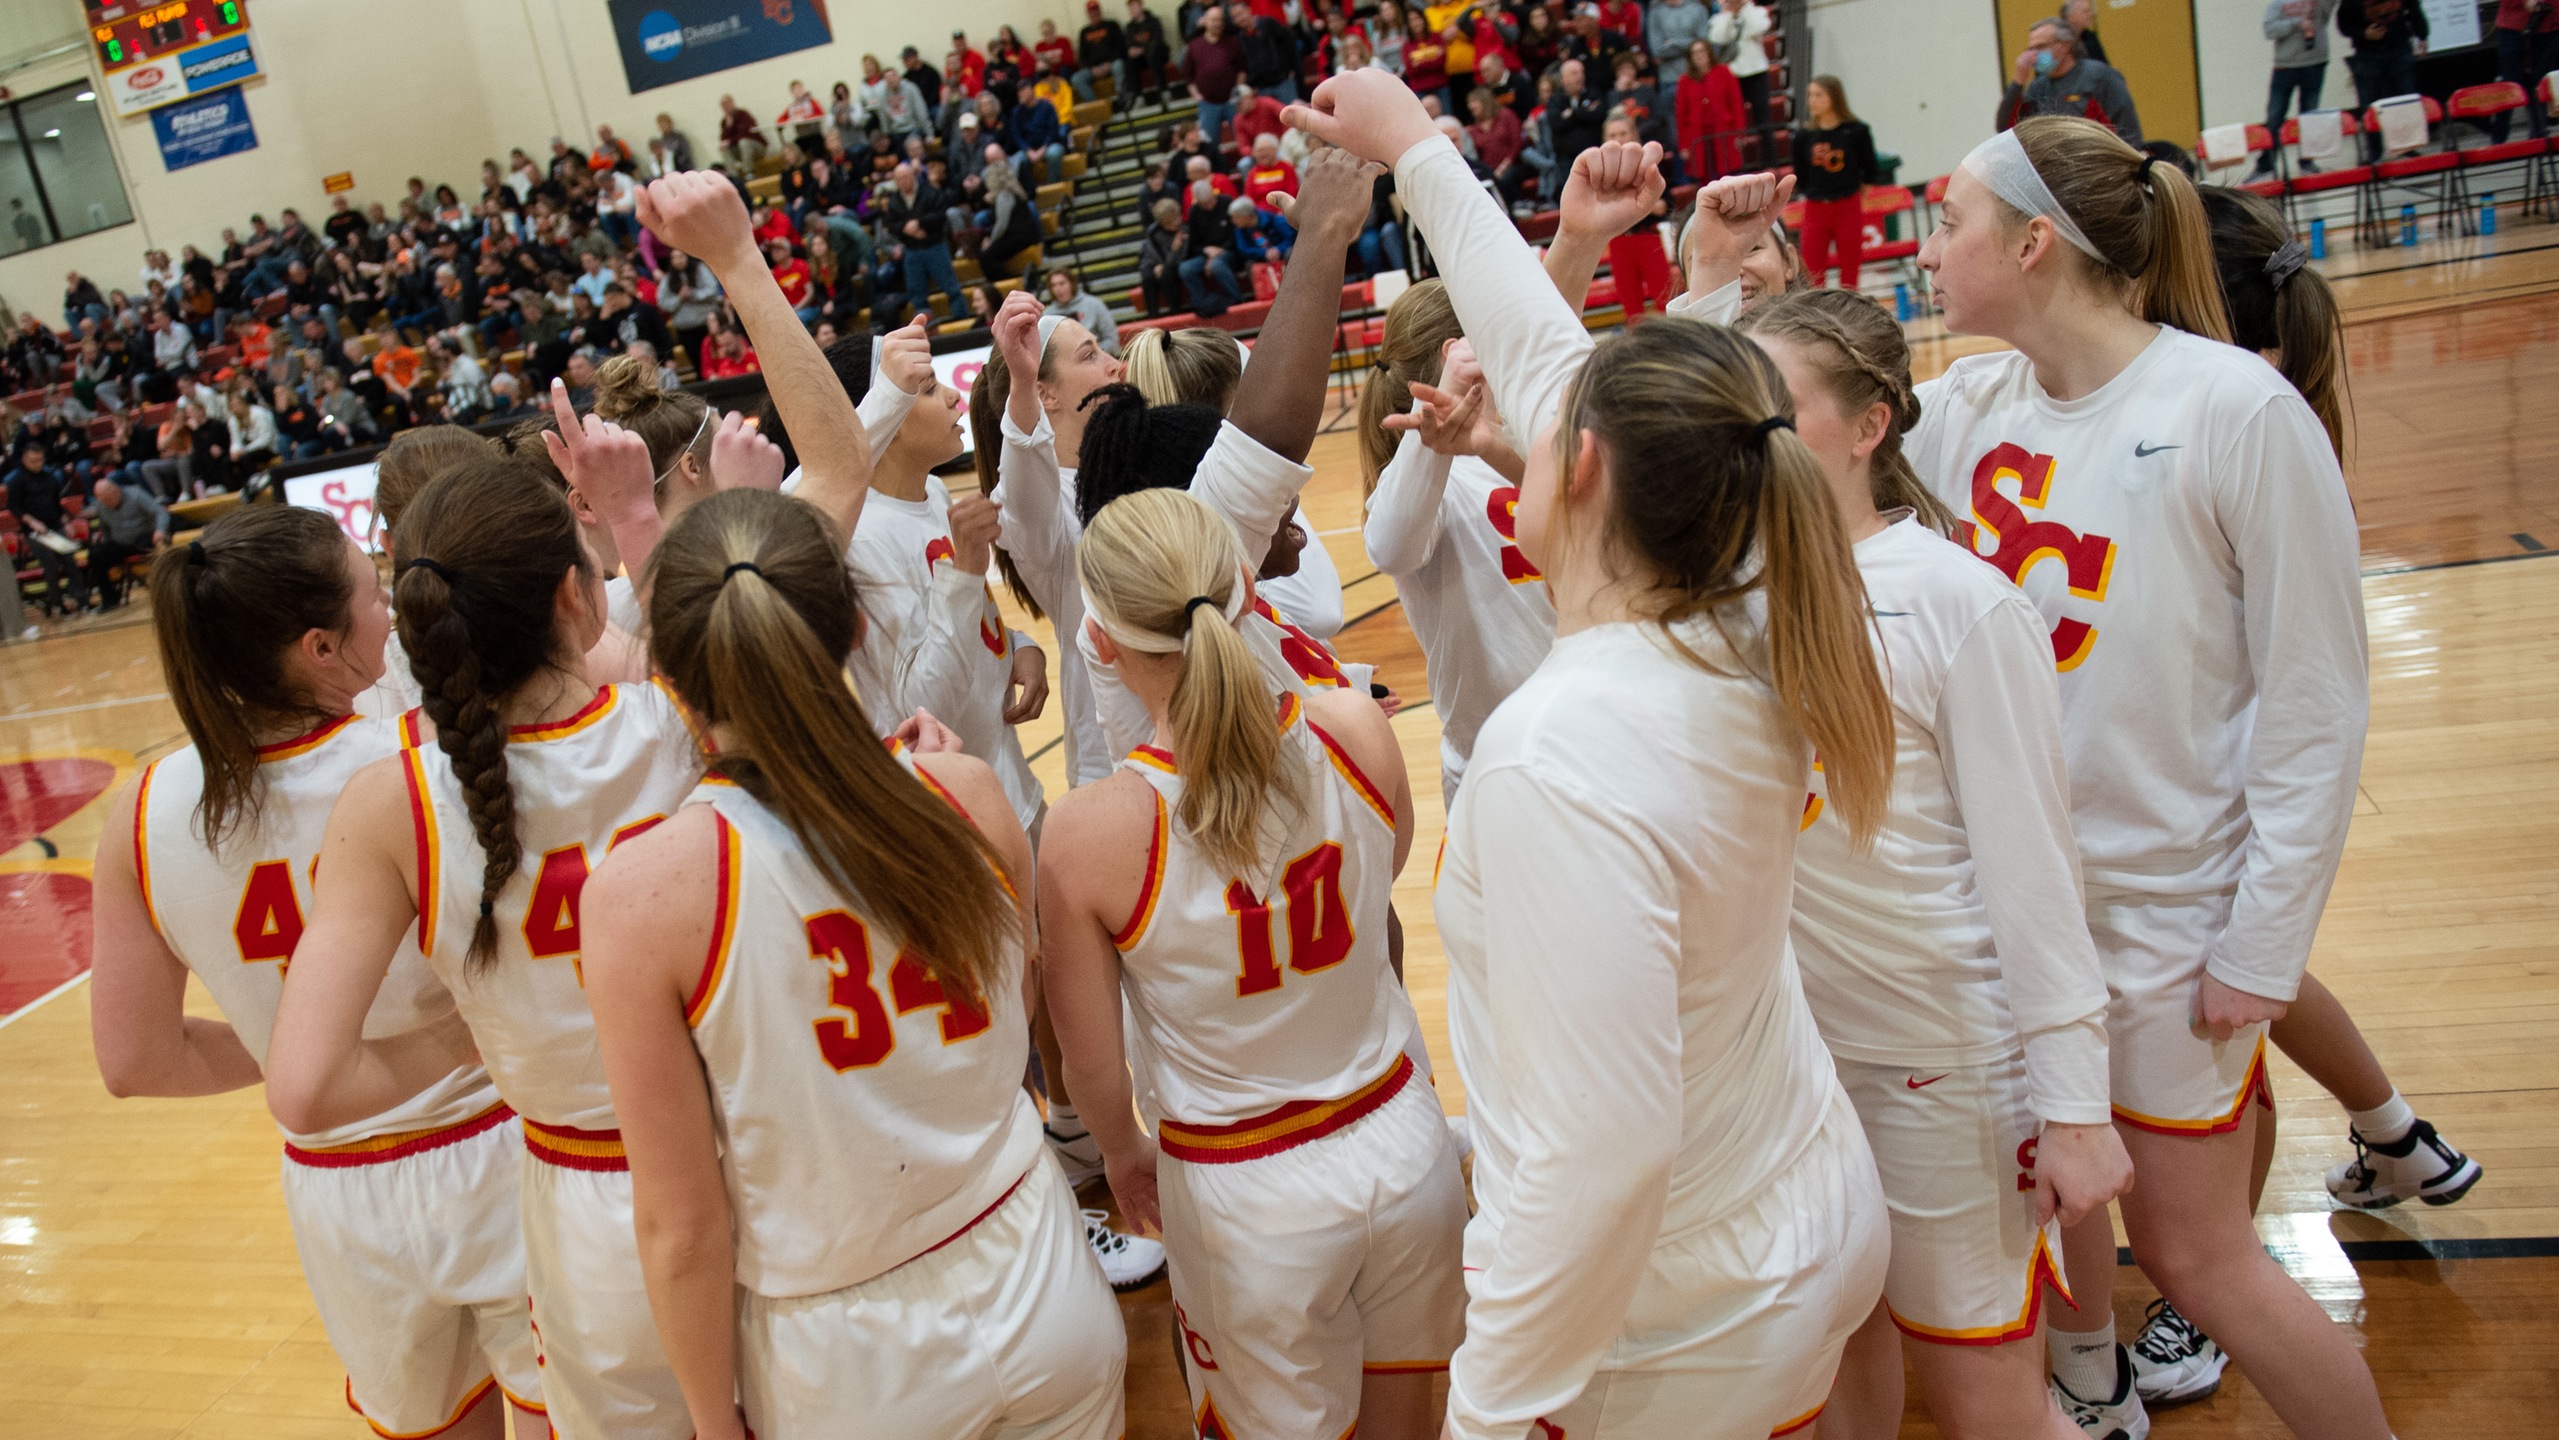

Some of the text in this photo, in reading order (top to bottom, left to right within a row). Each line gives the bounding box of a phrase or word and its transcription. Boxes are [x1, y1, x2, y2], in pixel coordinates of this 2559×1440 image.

[322, 481, 373, 542] SC
[521, 813, 668, 989] 4
[1223, 839, 1356, 998] 10
[803, 908, 992, 1075] 34
